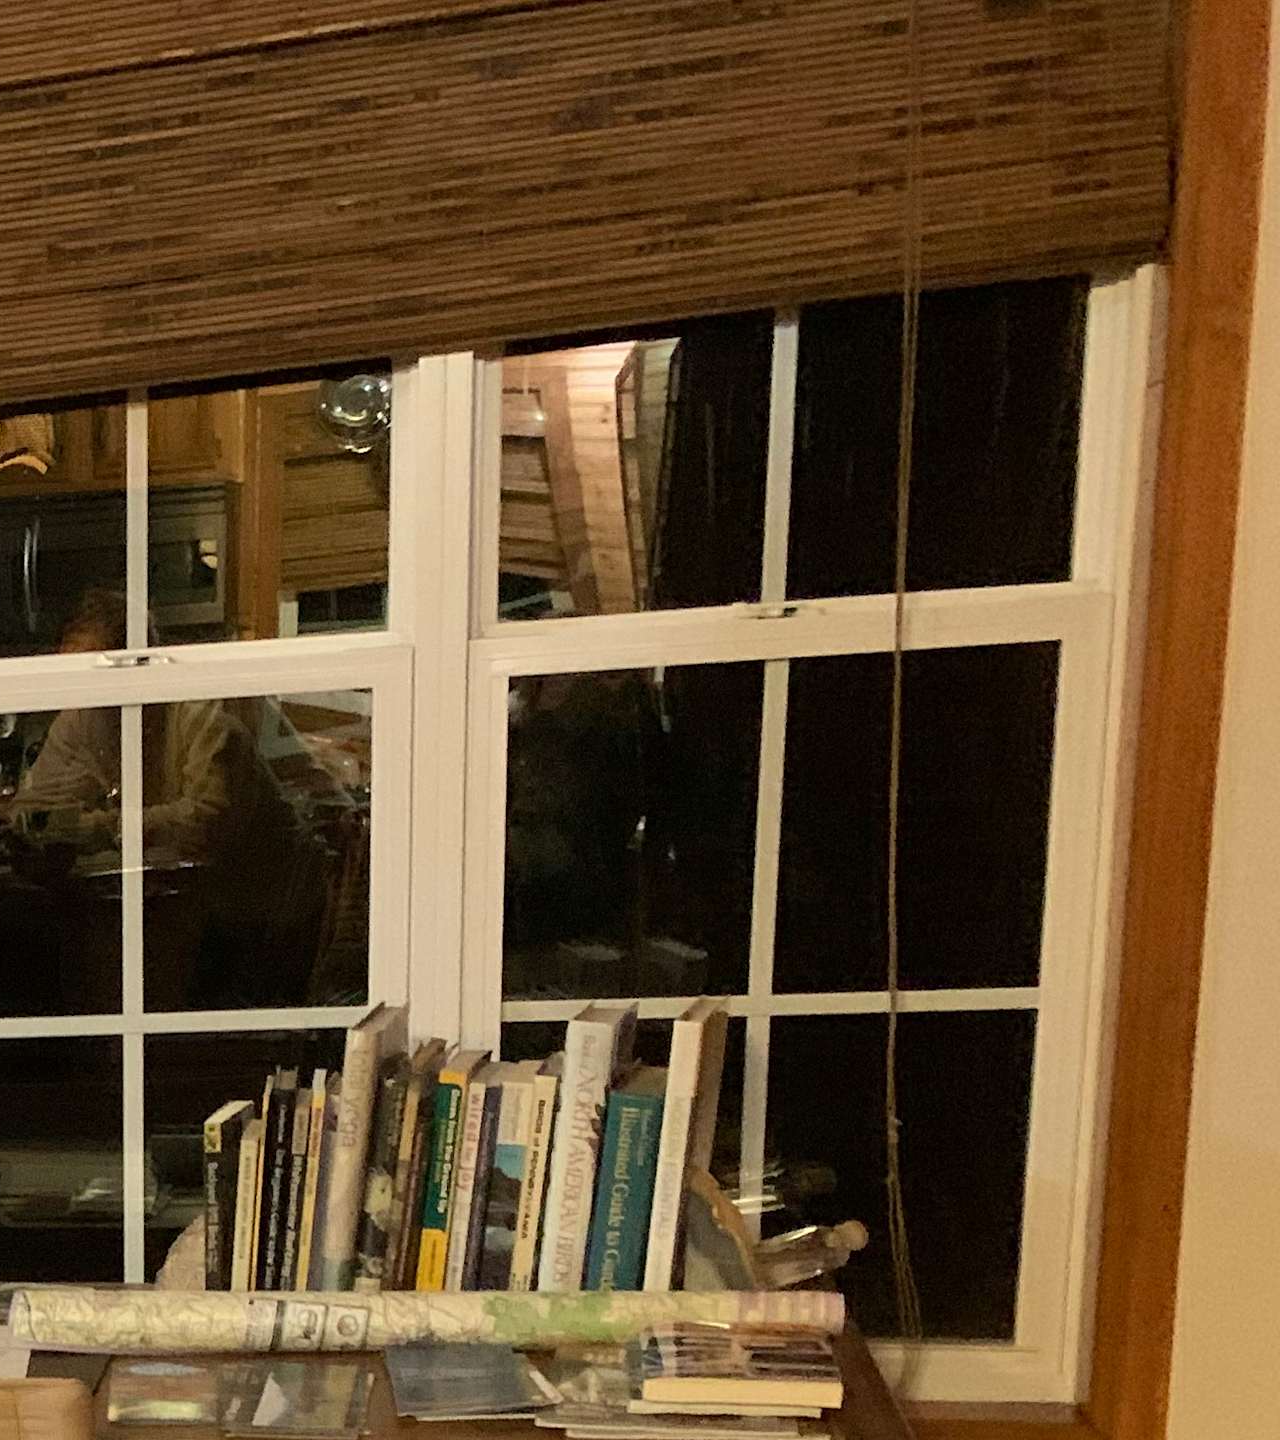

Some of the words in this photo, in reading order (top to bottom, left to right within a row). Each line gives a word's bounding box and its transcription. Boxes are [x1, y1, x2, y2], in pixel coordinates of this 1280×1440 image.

[613, 1106, 640, 1181] Illustrated
[607, 1183, 630, 1228] Guide
[605, 1229, 621, 1247] to
